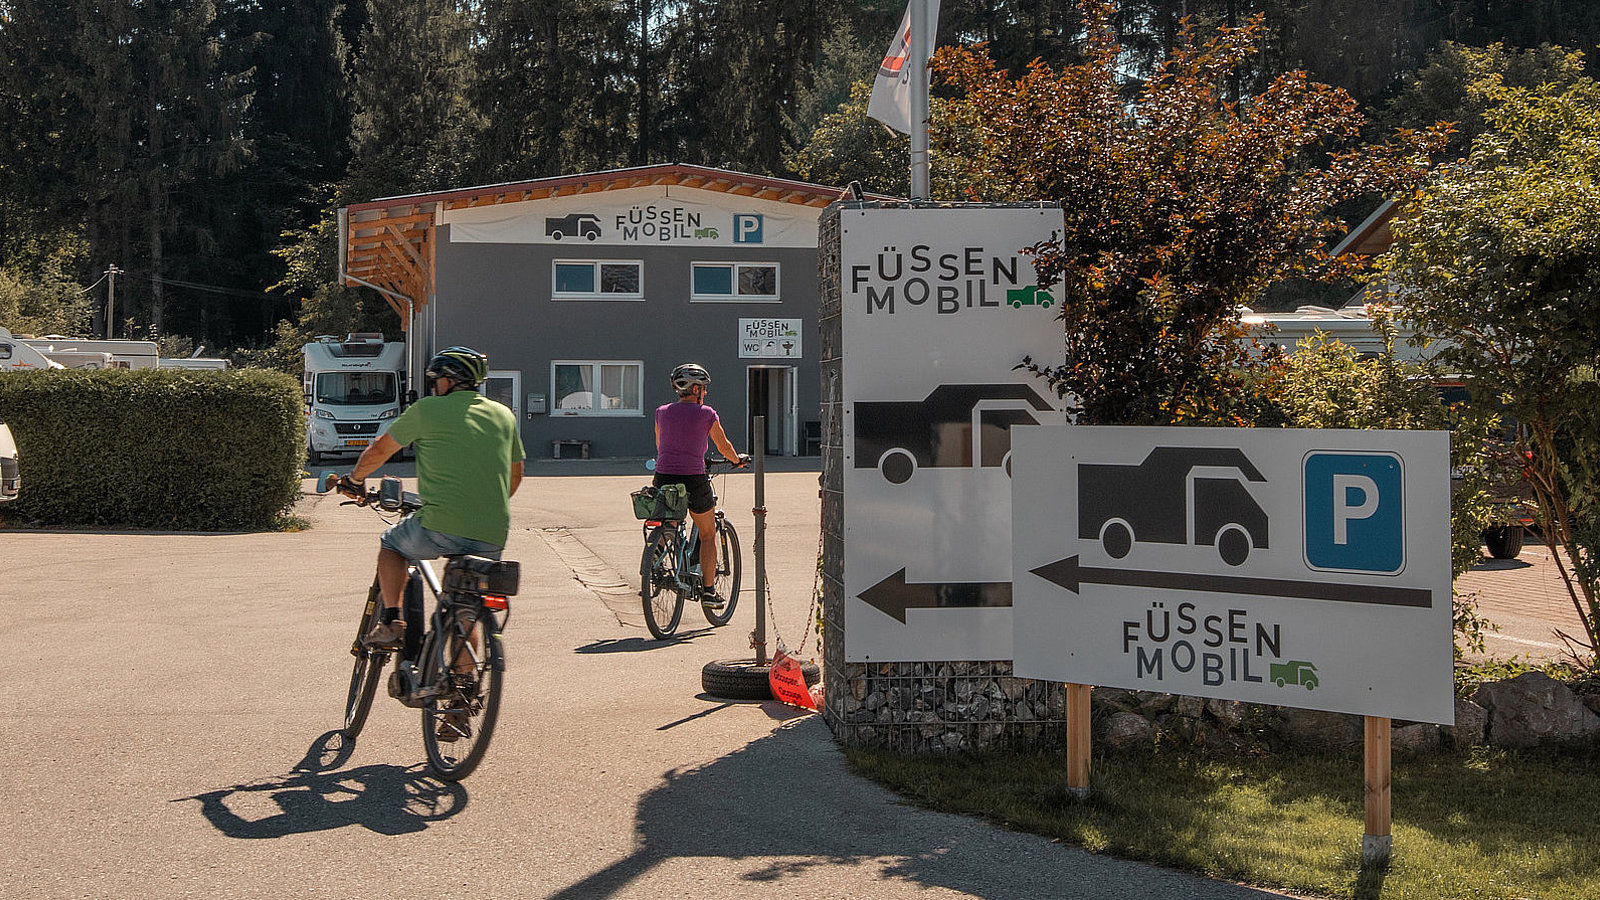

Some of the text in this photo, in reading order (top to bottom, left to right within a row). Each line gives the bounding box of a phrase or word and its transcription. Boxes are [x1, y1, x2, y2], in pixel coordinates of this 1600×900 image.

[616, 206, 701, 230] FÜSSEN
[623, 222, 691, 242] MOBIL
[739, 216, 759, 242] P
[852, 245, 1018, 294] FÜSSEN
[866, 277, 1000, 315] MOBIL
[744, 343, 760, 352] WC
[749, 328, 784, 338] MOBIL
[1333, 474, 1380, 545] P
[1123, 602, 1281, 658] FÜSSEN
[1136, 640, 1263, 687] MOBIL
